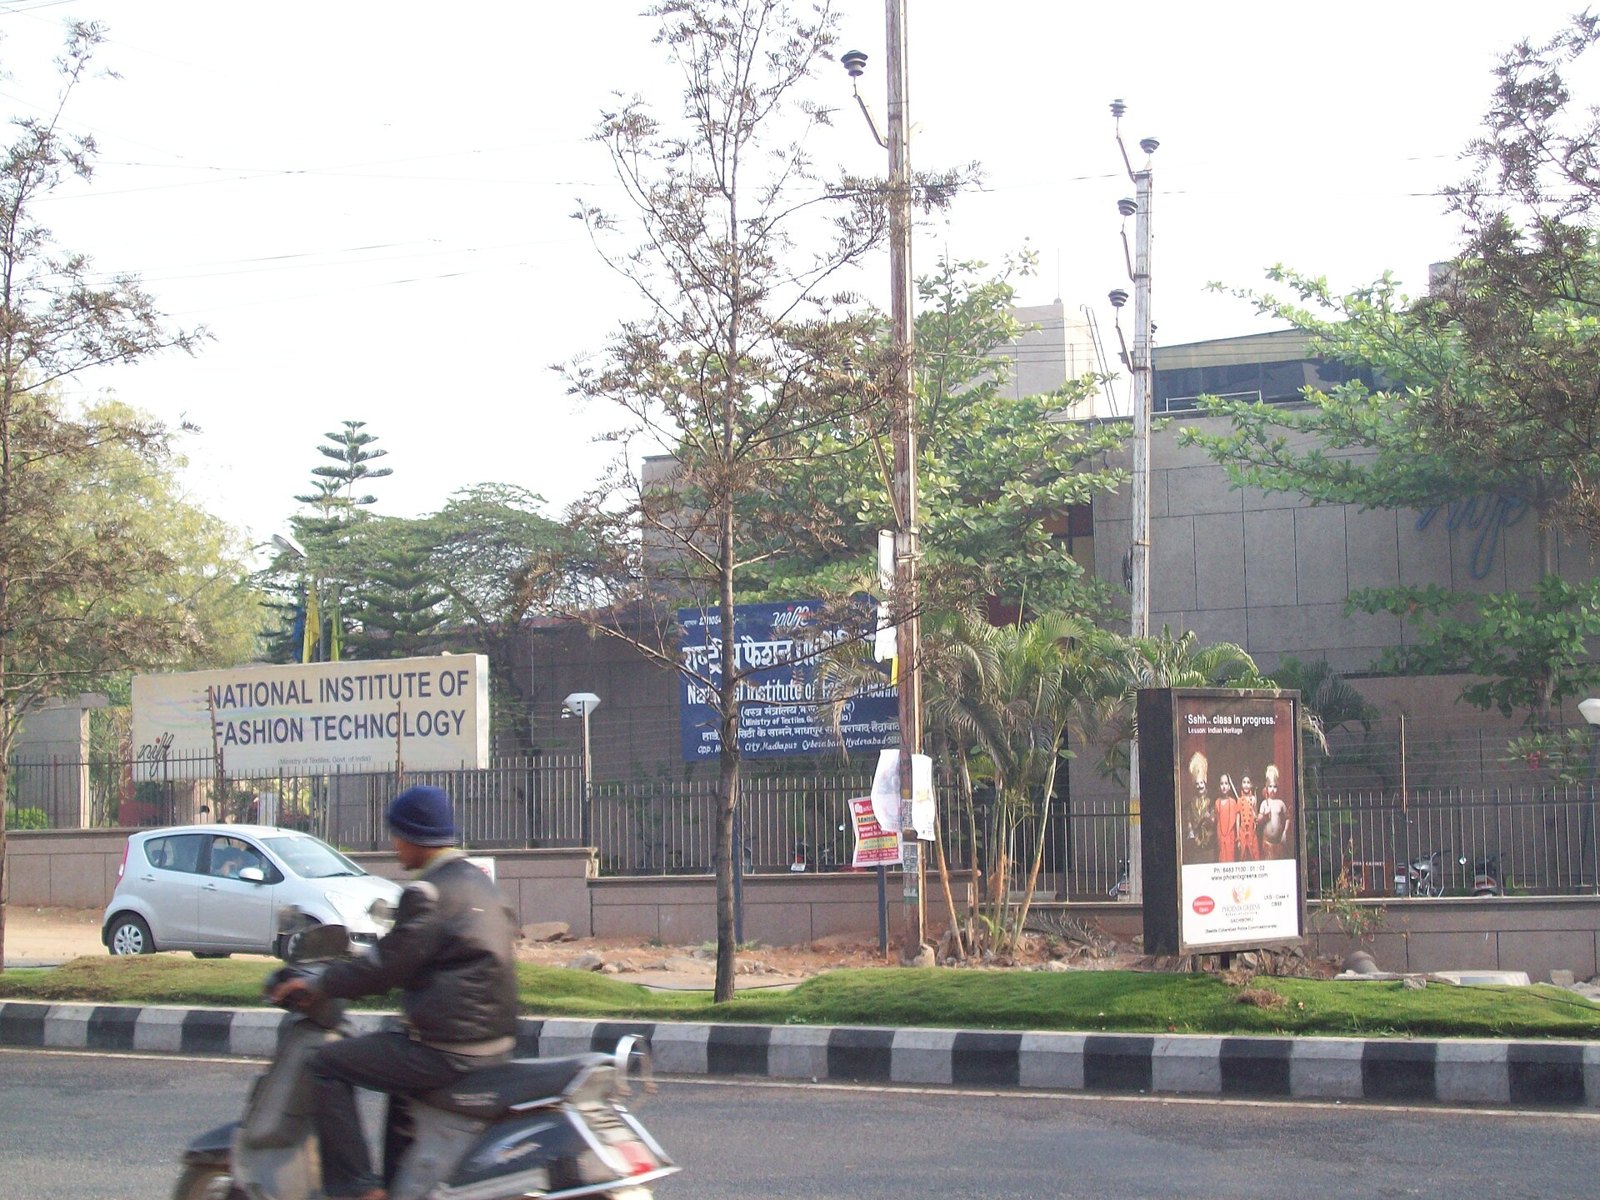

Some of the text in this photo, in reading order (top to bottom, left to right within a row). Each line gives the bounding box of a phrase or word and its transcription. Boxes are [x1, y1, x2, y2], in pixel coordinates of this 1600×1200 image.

[208, 670, 469, 709] NATIONAL INSTITUTE OF
[747, 679, 803, 702] Institute
[214, 709, 466, 746] FASHION TECHNOLOGY
[1207, 726, 1222, 734] Indian
[1223, 726, 1243, 735] Heritage
[1212, 713, 1232, 725] class
[1233, 713, 1241, 725] in
